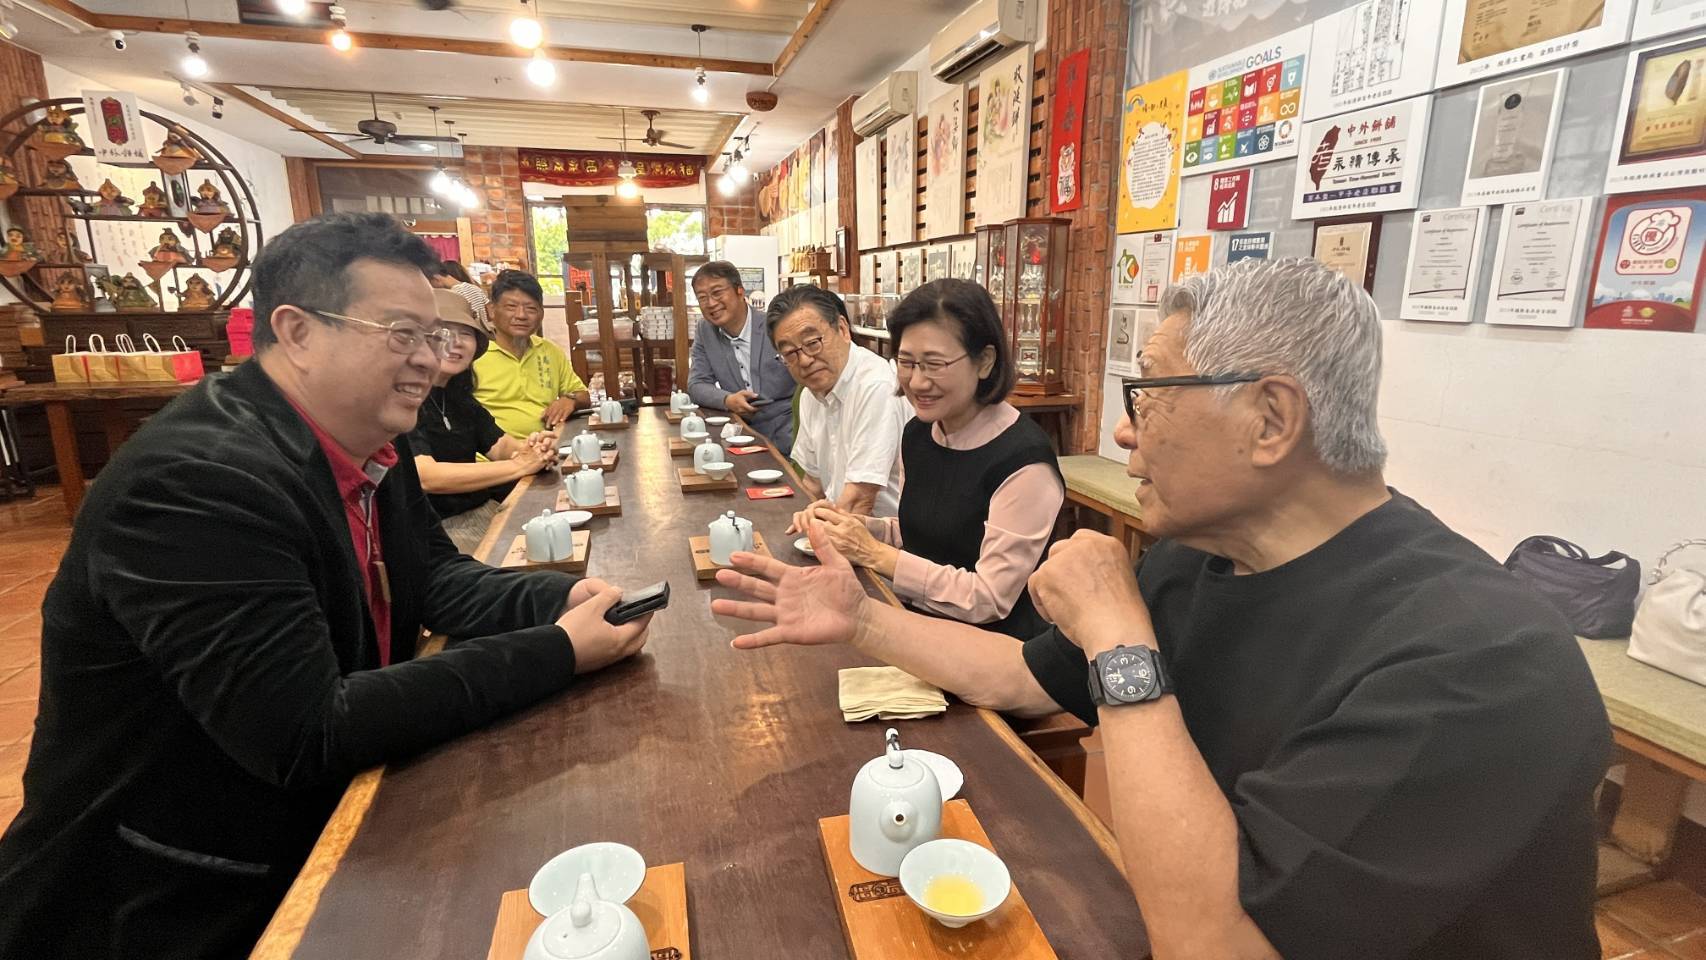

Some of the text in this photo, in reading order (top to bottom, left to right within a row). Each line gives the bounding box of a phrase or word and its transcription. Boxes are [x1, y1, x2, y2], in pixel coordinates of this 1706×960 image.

[1246, 46, 1282, 68] GOALS
[1347, 116, 1396, 137] 中外餅舖
[1332, 148, 1400, 171] 永續傳承
[1059, 175, 1072, 197] 福
[1213, 178, 1219, 191] 8
[1232, 238, 1239, 251] 17
[1645, 230, 1657, 242] 優
[1120, 657, 1129, 665] 3
